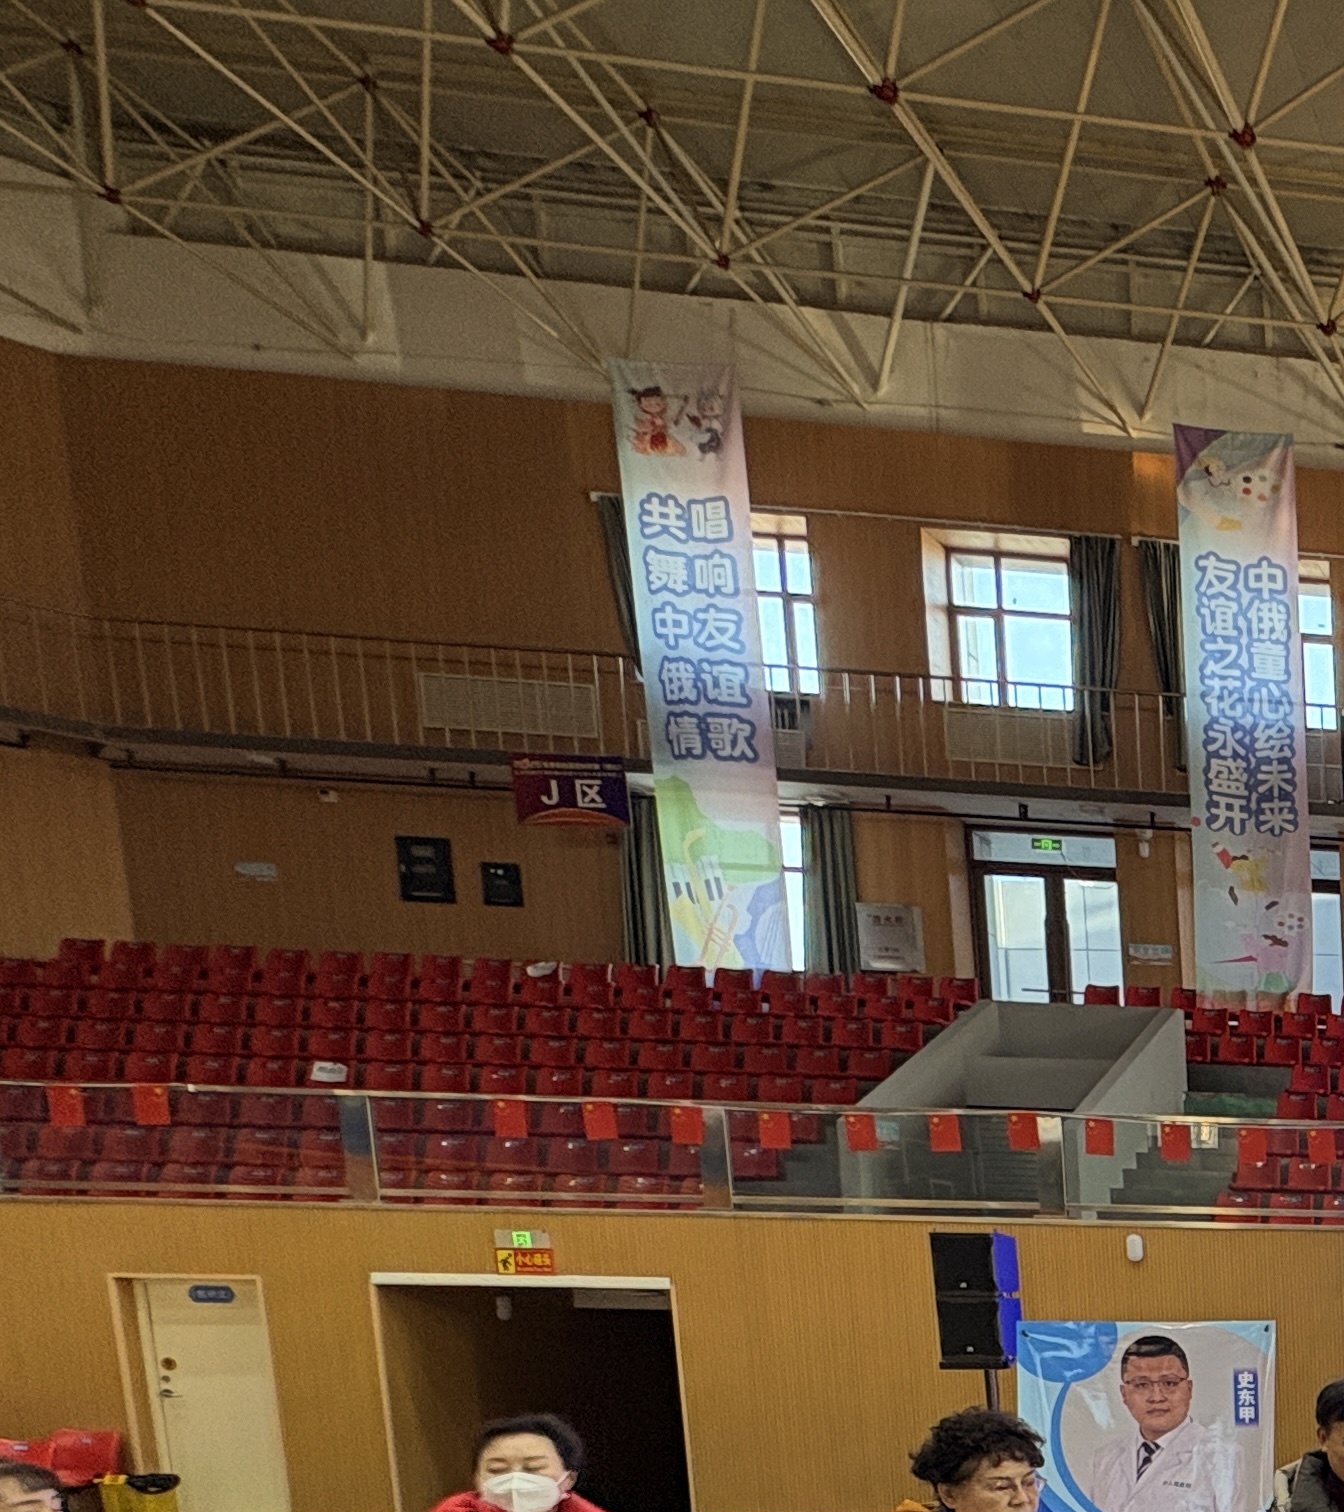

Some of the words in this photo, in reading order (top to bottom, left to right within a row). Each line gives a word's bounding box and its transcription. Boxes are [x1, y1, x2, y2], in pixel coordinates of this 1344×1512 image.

[640, 493, 704, 760] 共舞中俄情
[688, 496, 758, 761] 唱响友谊歌
[1195, 551, 1252, 836] 友谊之花永盛开
[1244, 556, 1298, 836] 中俄童心绘未来
